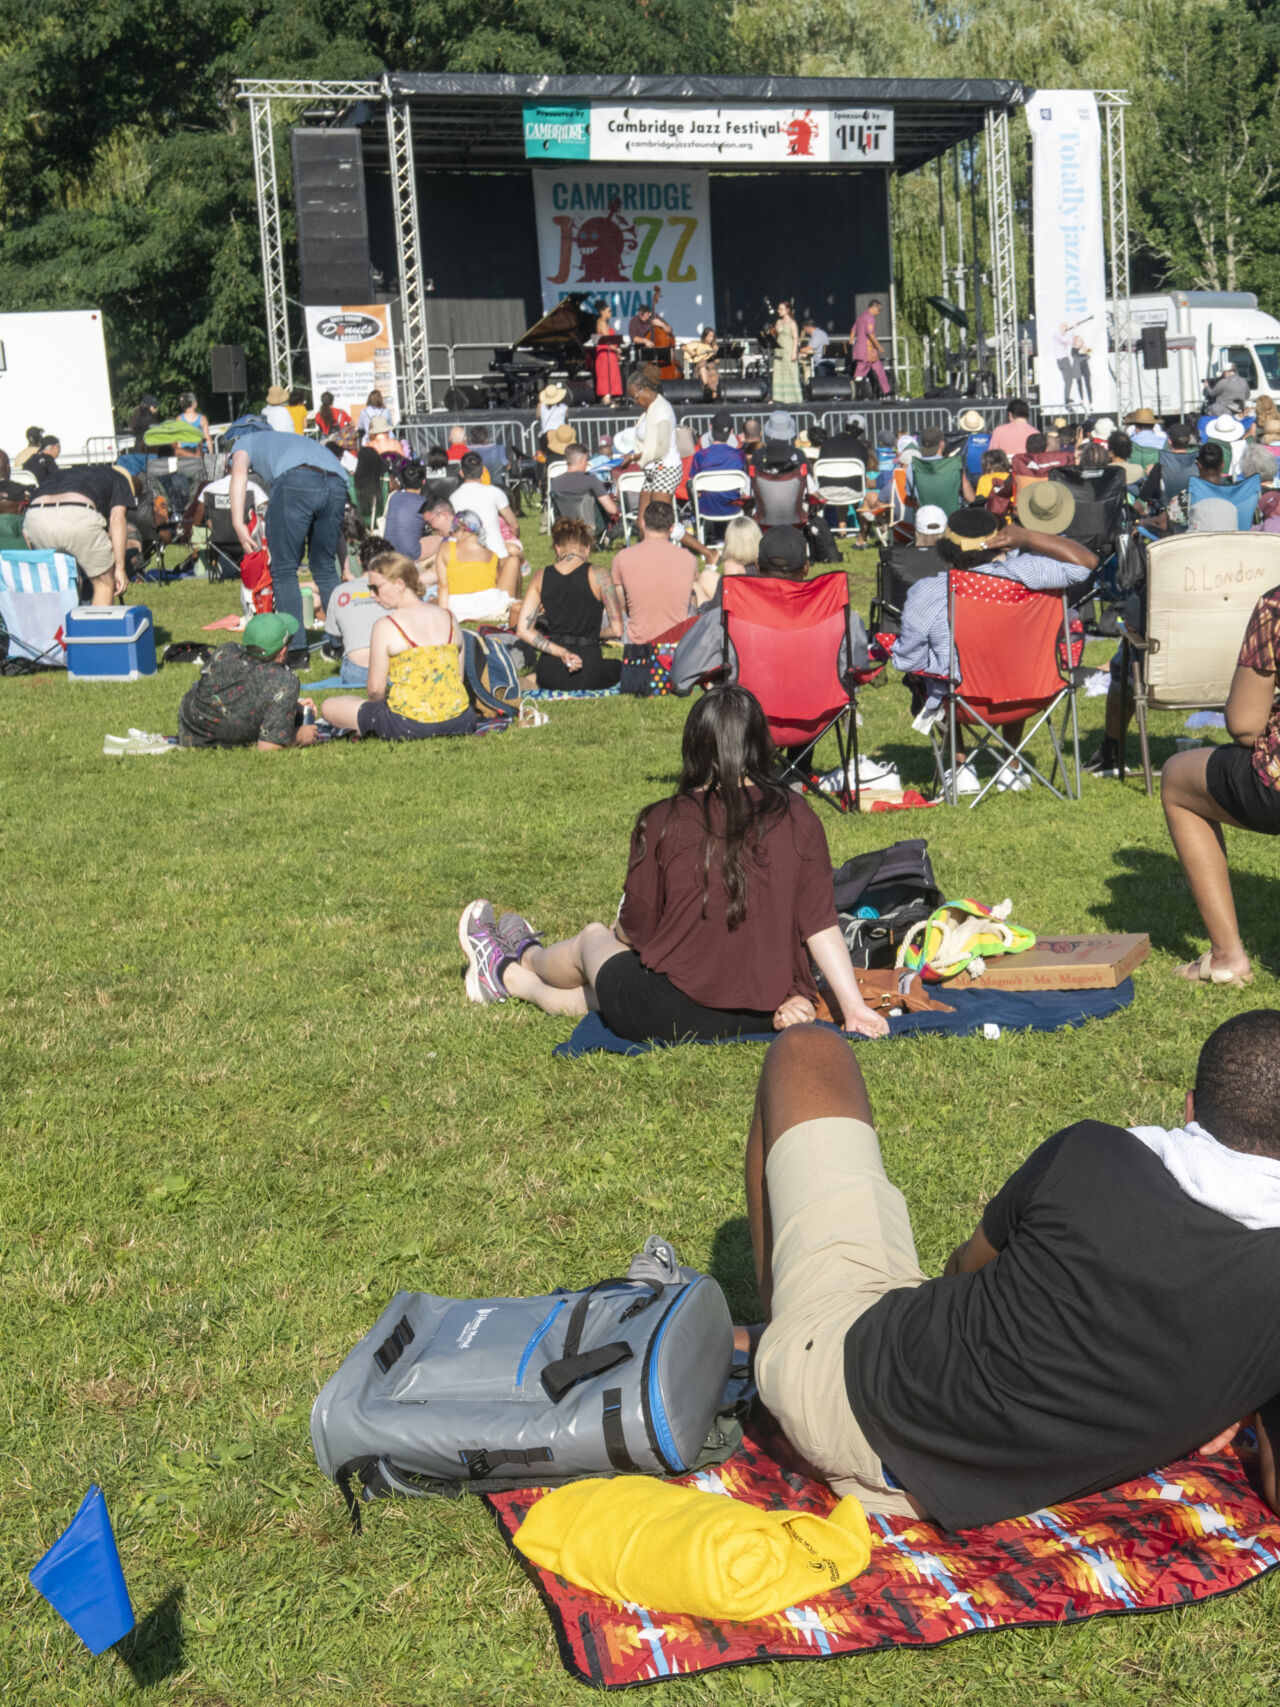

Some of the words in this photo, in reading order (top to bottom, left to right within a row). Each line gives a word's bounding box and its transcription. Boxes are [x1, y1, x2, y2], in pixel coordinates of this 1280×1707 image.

[608, 120, 685, 137] Cambridge
[690, 121, 721, 134] Jazz
[726, 121, 780, 135] Festival
[834, 112, 870, 120] Sponsor
[1058, 127, 1085, 219] Totally
[552, 182, 694, 211] CAMBRIDGE
[1059, 224, 1087, 313] jazzed!
